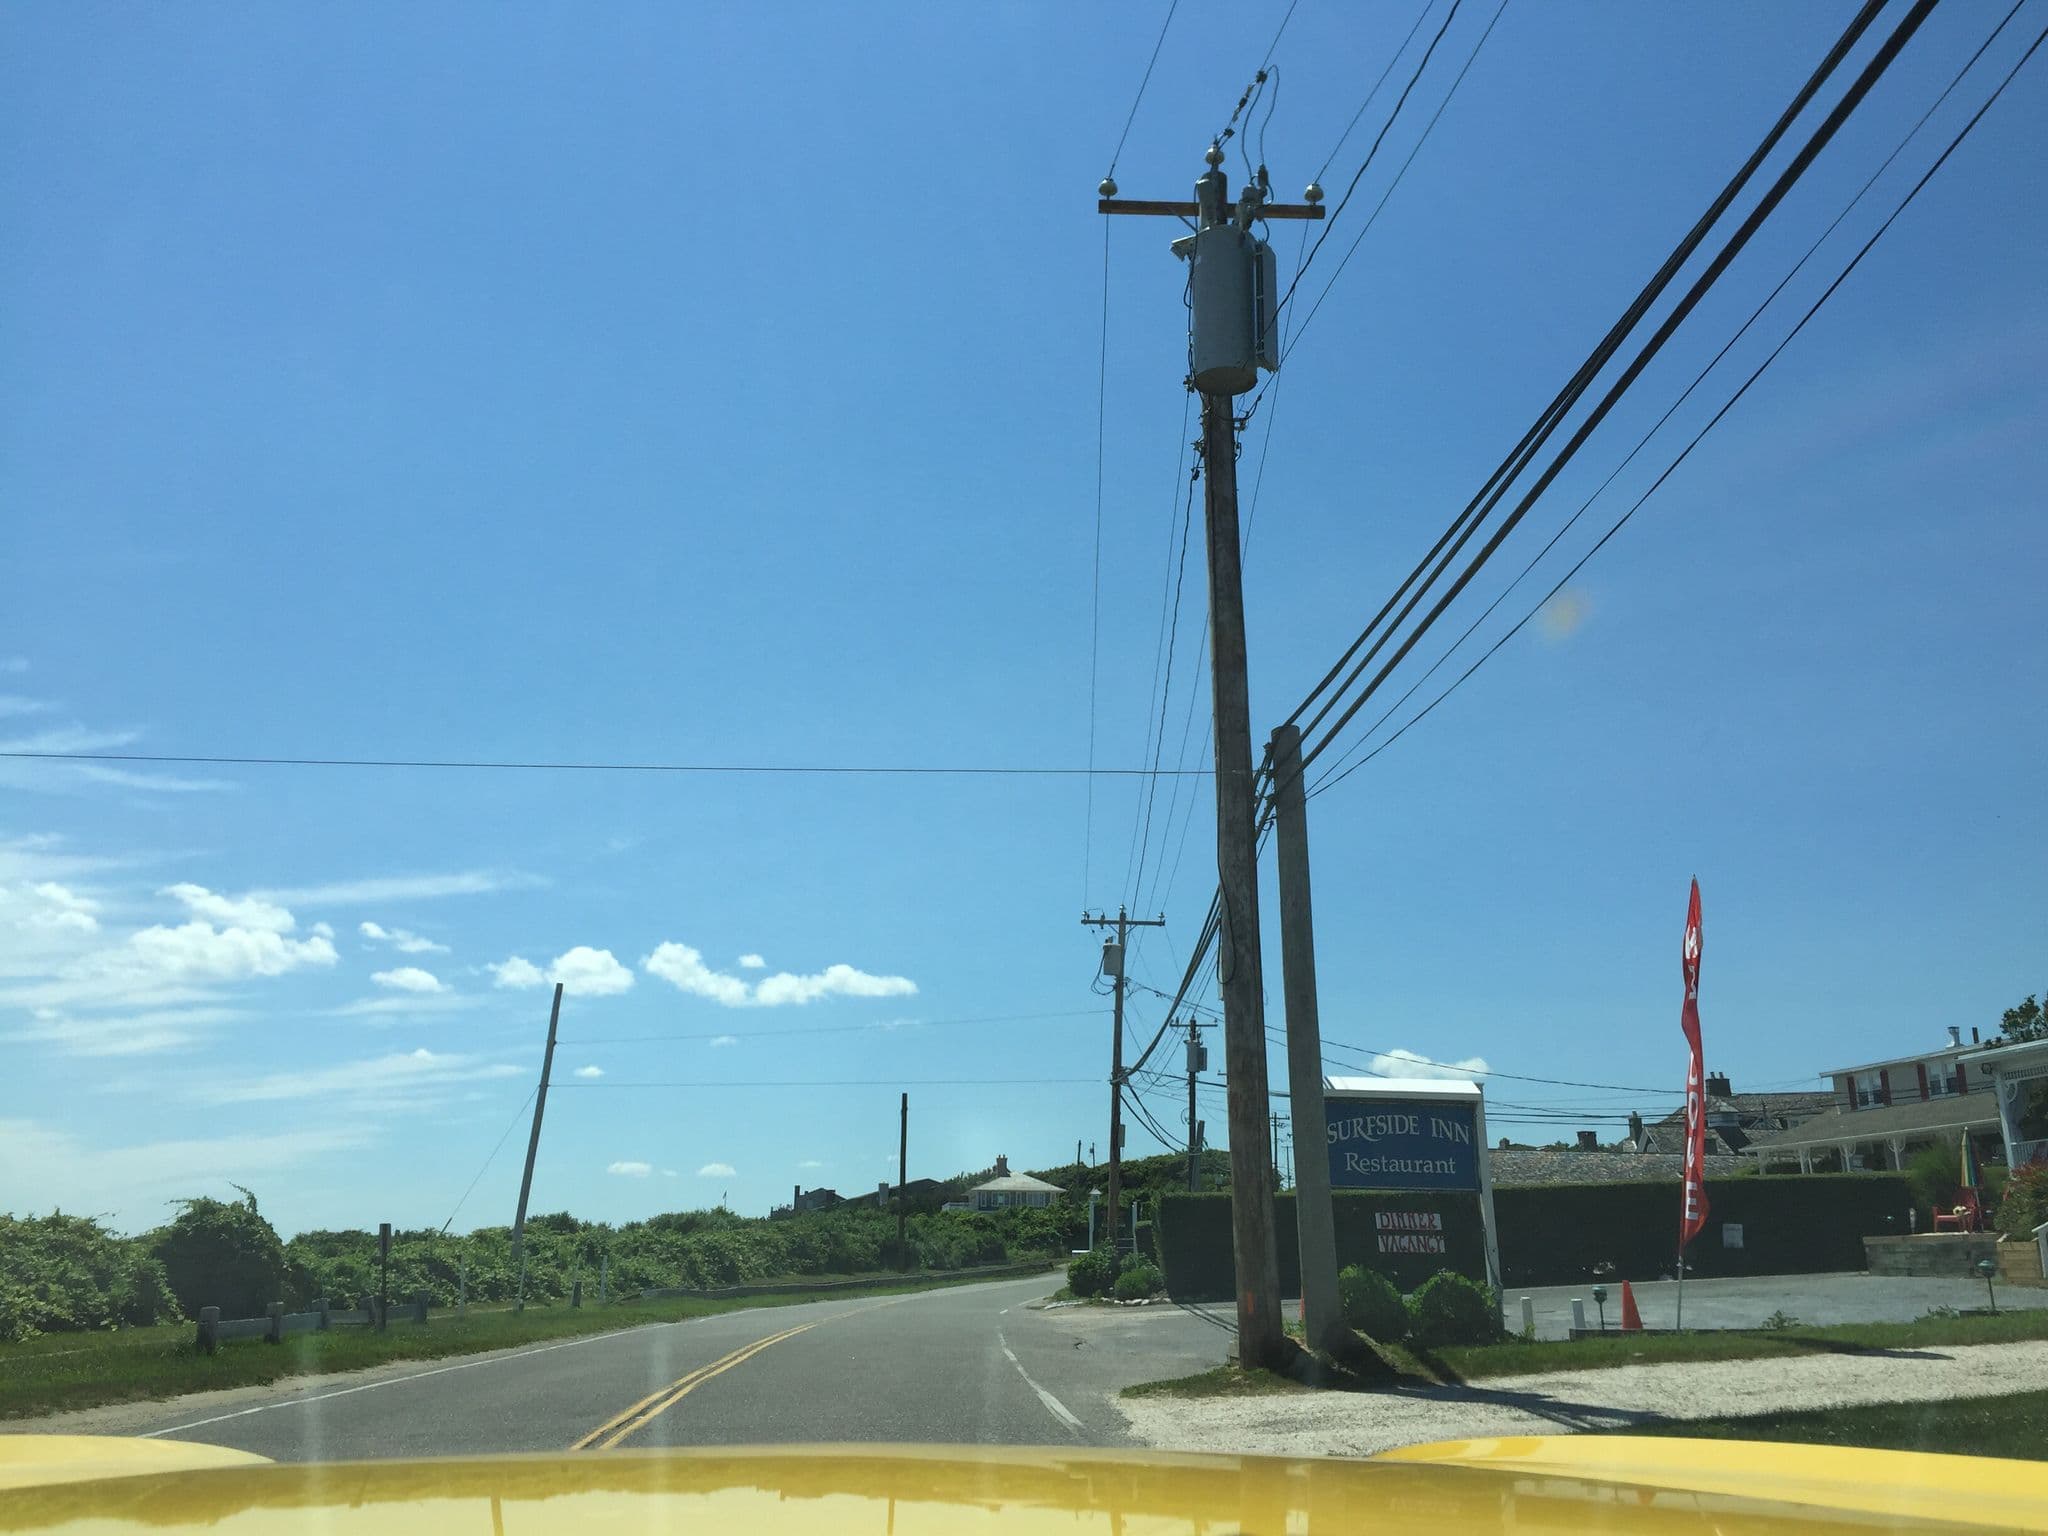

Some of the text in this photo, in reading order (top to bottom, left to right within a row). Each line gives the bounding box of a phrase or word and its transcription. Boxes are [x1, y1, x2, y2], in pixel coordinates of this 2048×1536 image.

[1327, 1114, 1469, 1144] SURFSIDE INN
[1344, 1152, 1456, 1176] Restaurant
[1379, 1211, 1437, 1229] DINNER
[1380, 1234, 1445, 1252] VACANCY
